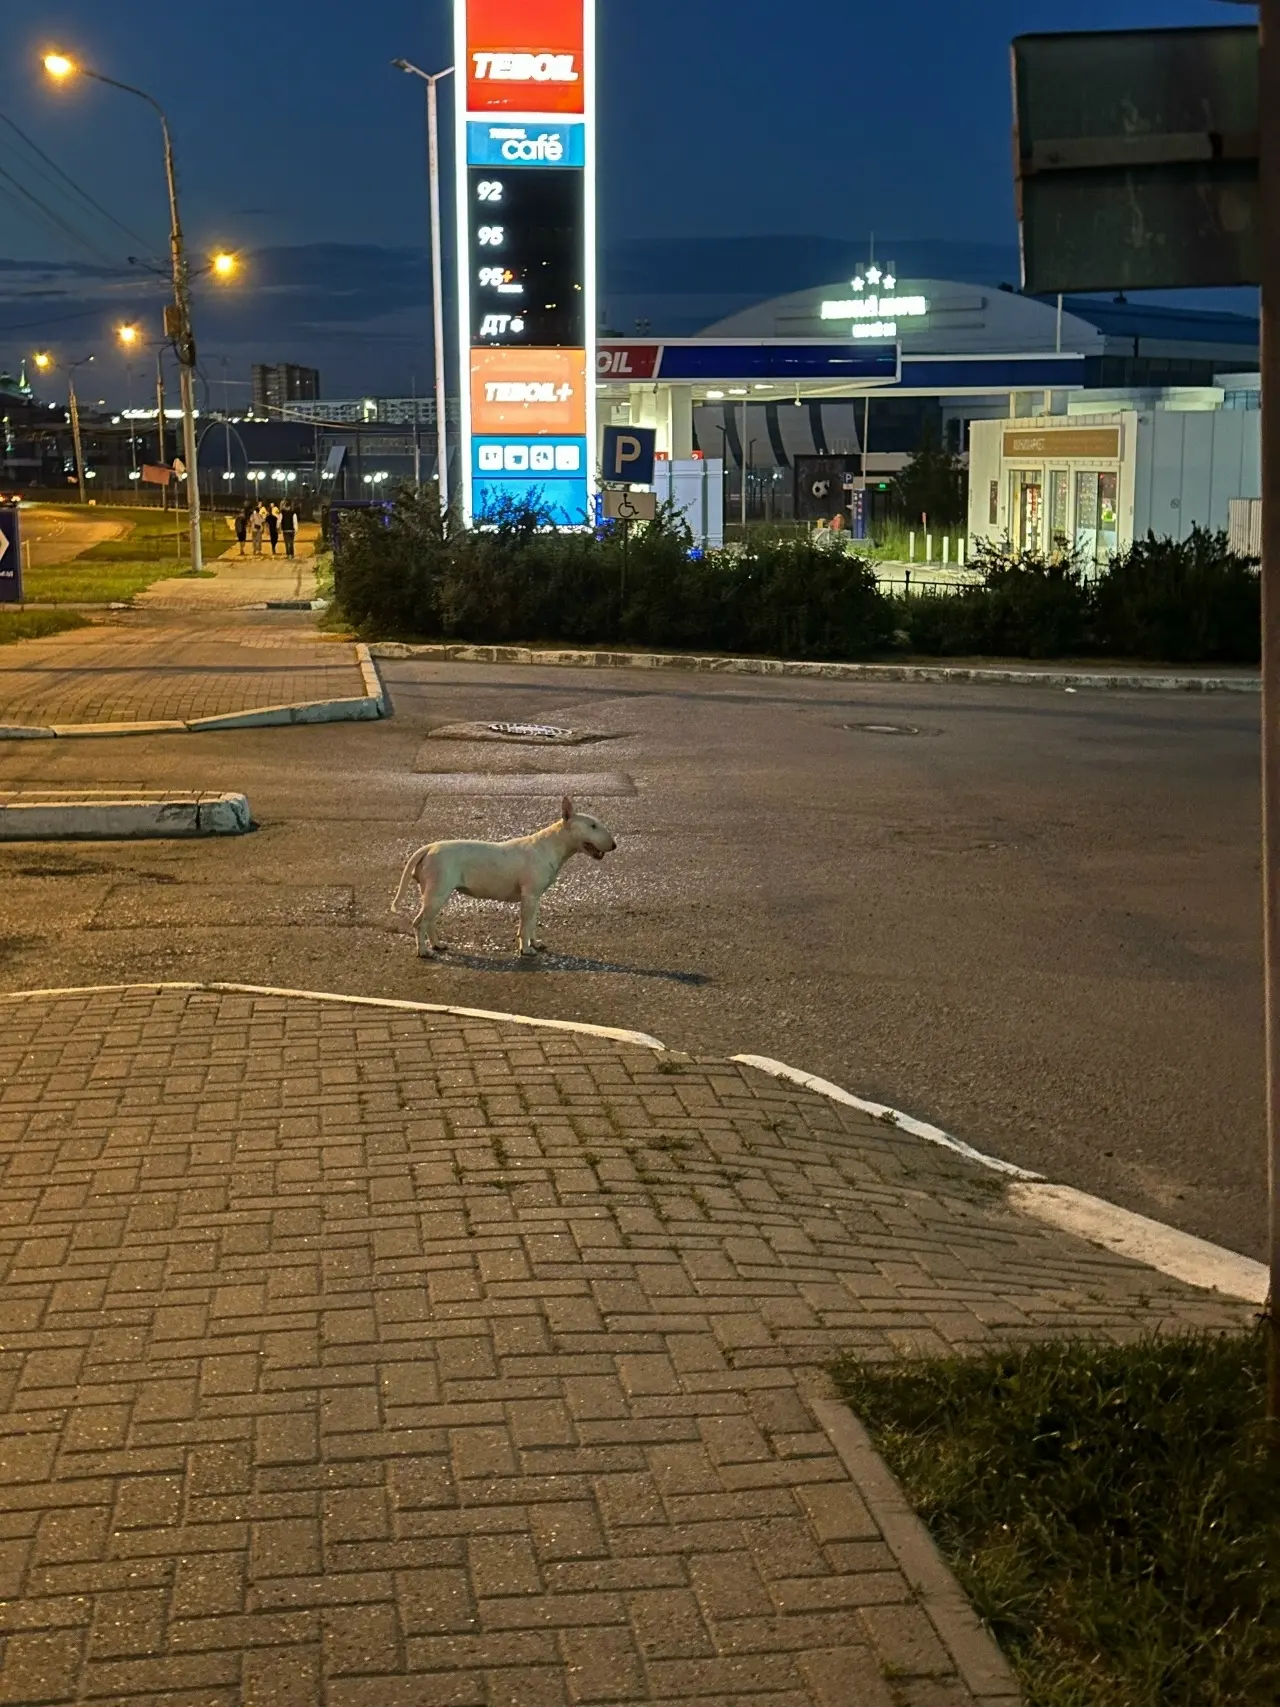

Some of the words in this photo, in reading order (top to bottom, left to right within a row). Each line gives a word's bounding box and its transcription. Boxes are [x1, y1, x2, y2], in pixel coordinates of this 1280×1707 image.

[502, 133, 563, 160] café
[477, 181, 503, 201] 92
[478, 226, 504, 246] 95
[480, 315, 511, 336] ДТ
[615, 435, 641, 474] P
[845, 473, 852, 483] P
